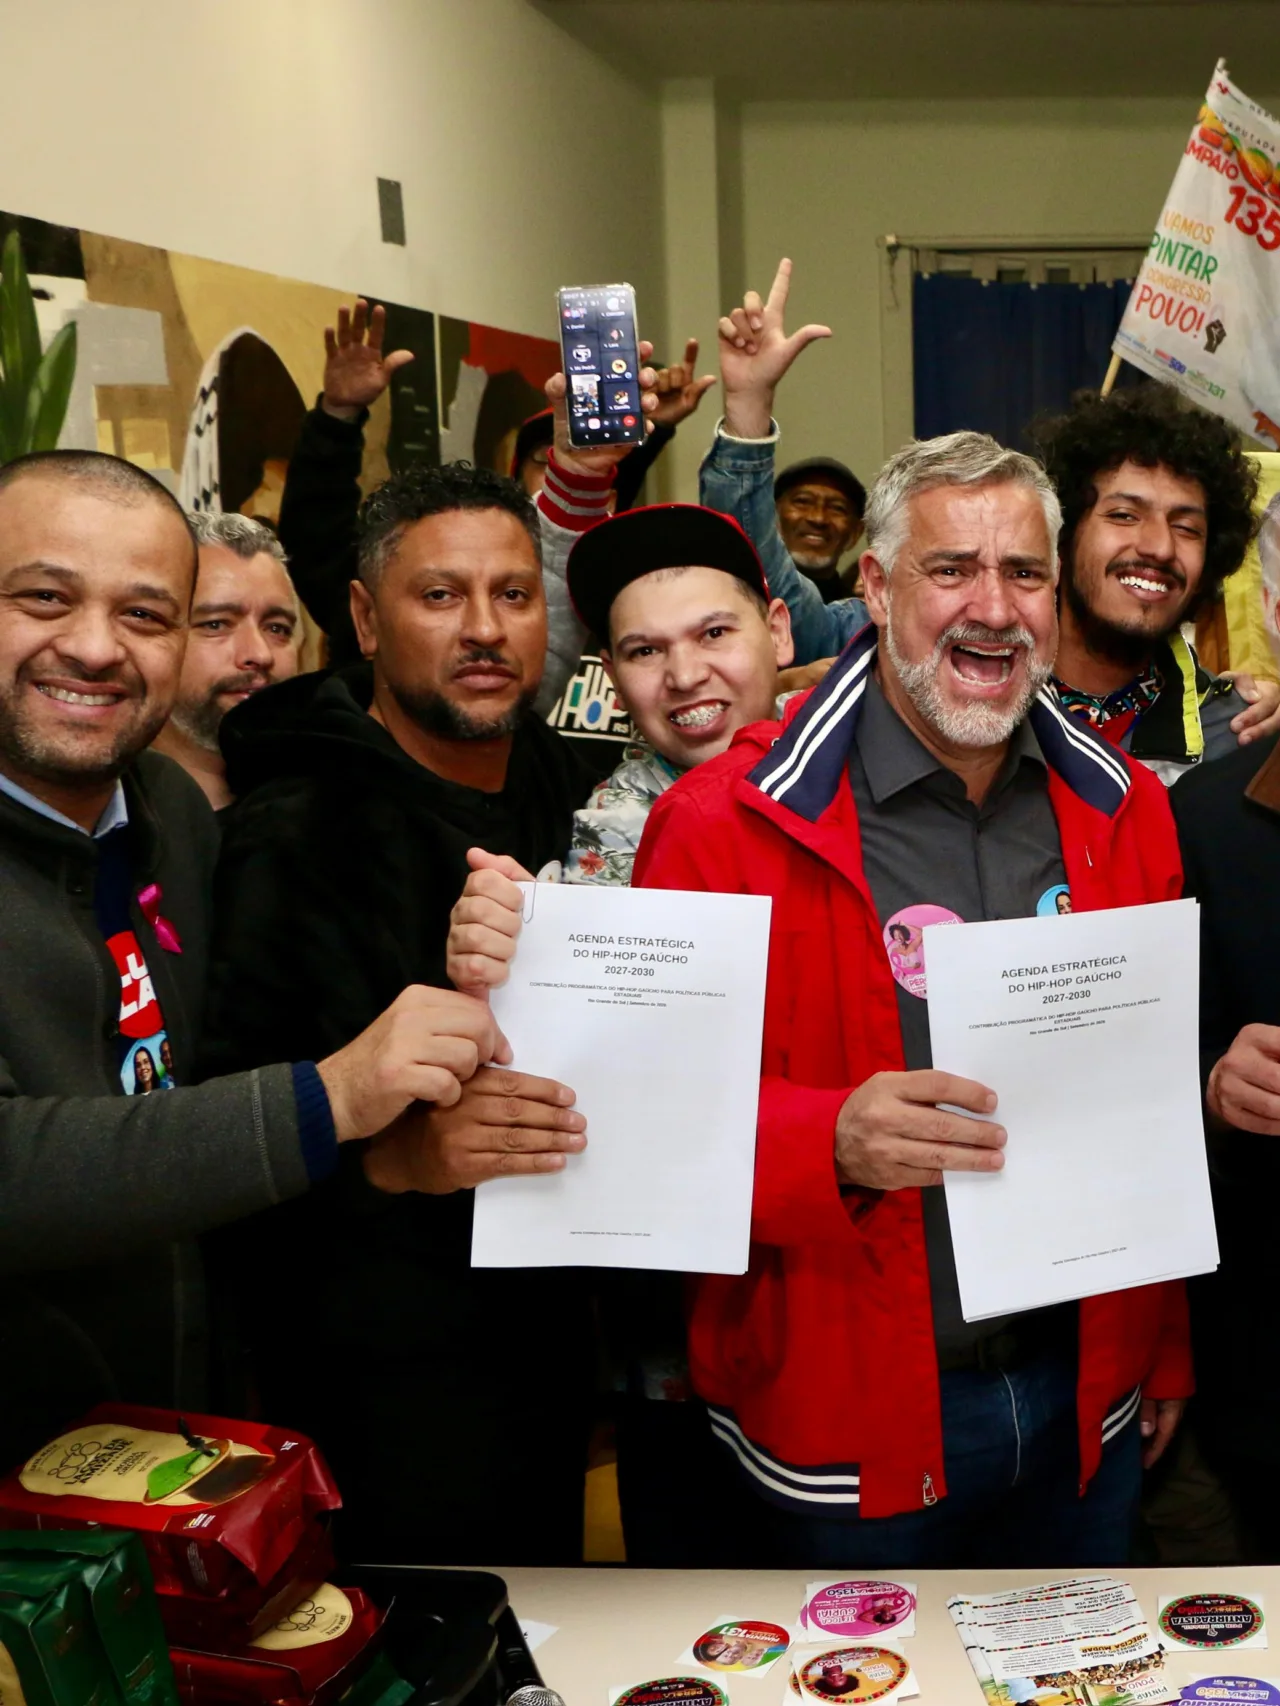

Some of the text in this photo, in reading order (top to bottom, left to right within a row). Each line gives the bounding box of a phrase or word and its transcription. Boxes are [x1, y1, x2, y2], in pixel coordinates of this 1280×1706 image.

[1163, 210, 1214, 245] VAMOS
[1146, 231, 1218, 284] PINTAR
[1146, 268, 1211, 306] CONGRESSO
[1135, 284, 1205, 338] POVO!
[568, 934, 695, 949] AGENDA ESTRATÉGICA
[573, 949, 688, 964] DO HIP-HOP GAÚCHO
[604, 966, 655, 976] 2027-2030
[1001, 955, 1127, 979] AGENDA ESTRATÉGICA
[1008, 970, 1122, 994] DO HIP-HOP GAÚCHO
[1042, 989, 1091, 1004] 2027-2030
[78, 1440, 133, 1483] AMIZADE
[827, 1588, 855, 1596] 1350
[1171, 1614, 1252, 1626] ANTIRRACISTA
[719, 1626, 780, 1642] PIMENTA 131
[1081, 1633, 1147, 1654] PRECISA MUDAR
[1137, 1686, 1168, 1700] PINTAR
[1197, 1688, 1228, 1698] 1350
